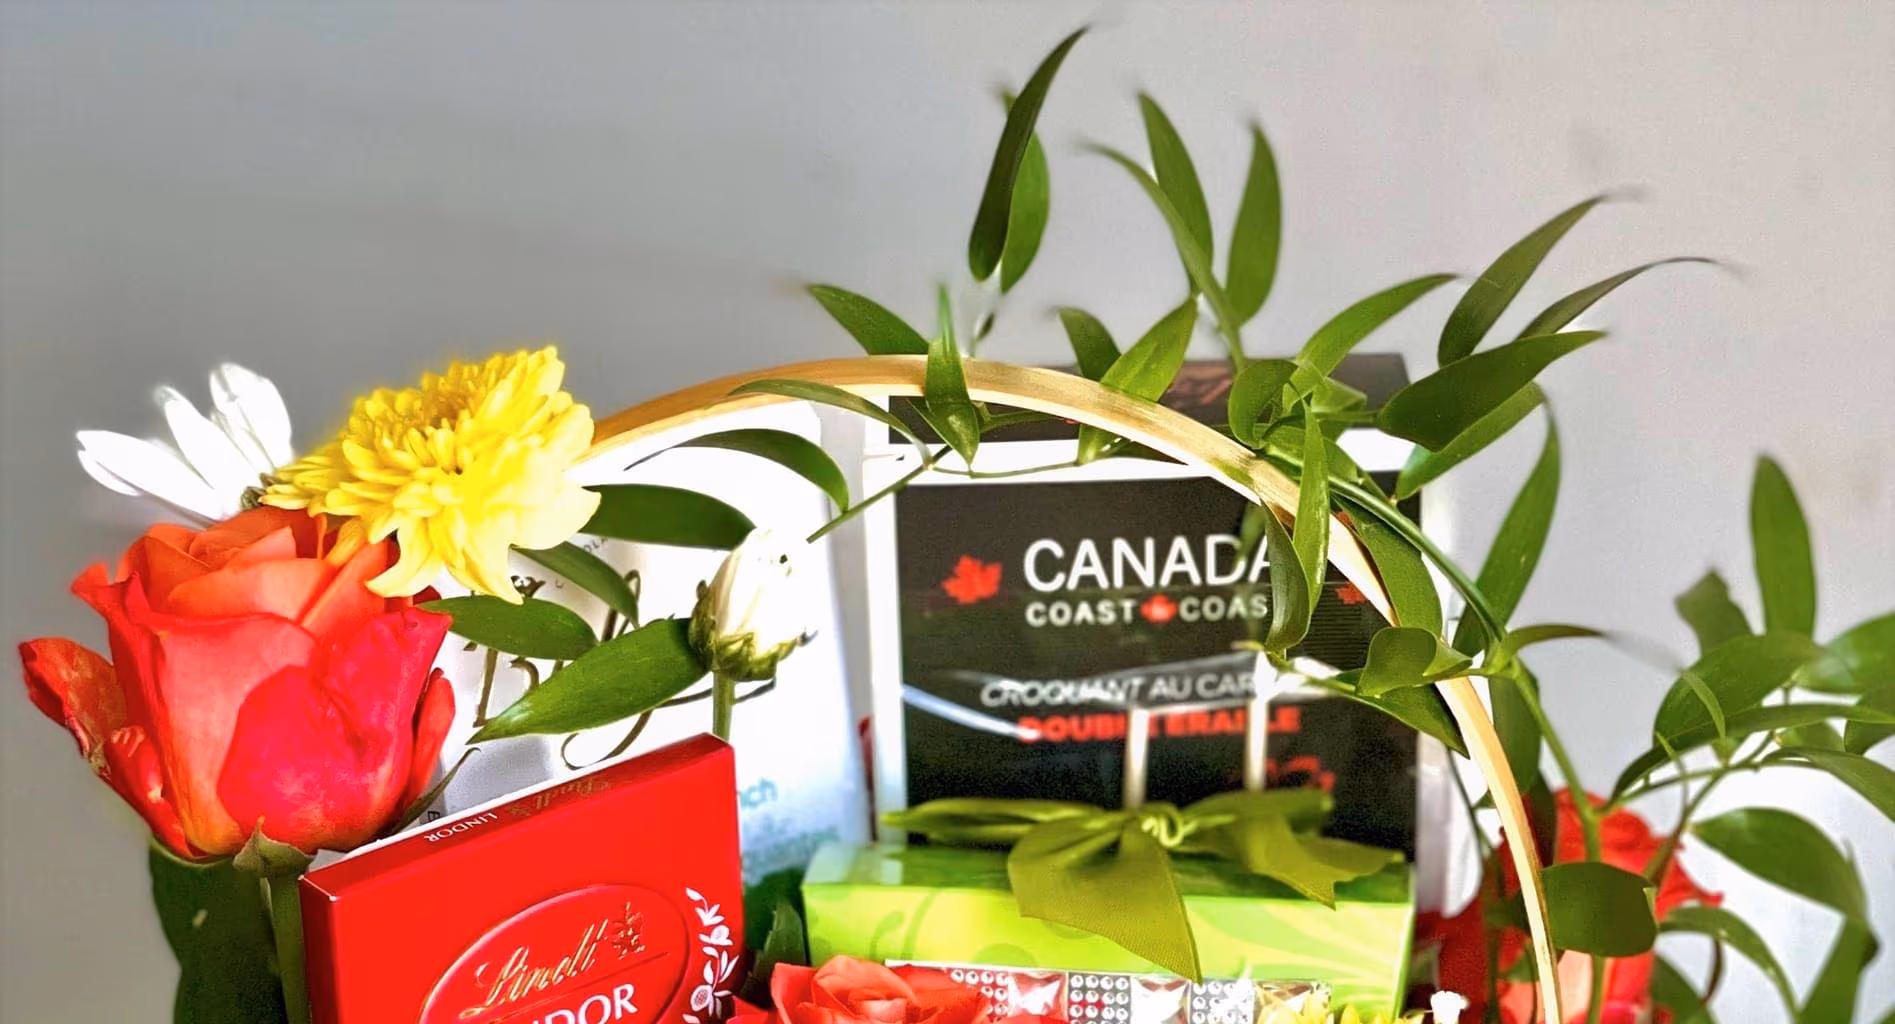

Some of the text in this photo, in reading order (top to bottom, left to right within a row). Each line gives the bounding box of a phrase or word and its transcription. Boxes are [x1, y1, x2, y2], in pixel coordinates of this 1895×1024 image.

[1026, 600, 1137, 627] COAST
[1179, 595, 1269, 622] COAS
[1150, 676, 1192, 700] AU
[424, 812, 498, 843] LINDOR
[458, 919, 608, 1020] Lindt
